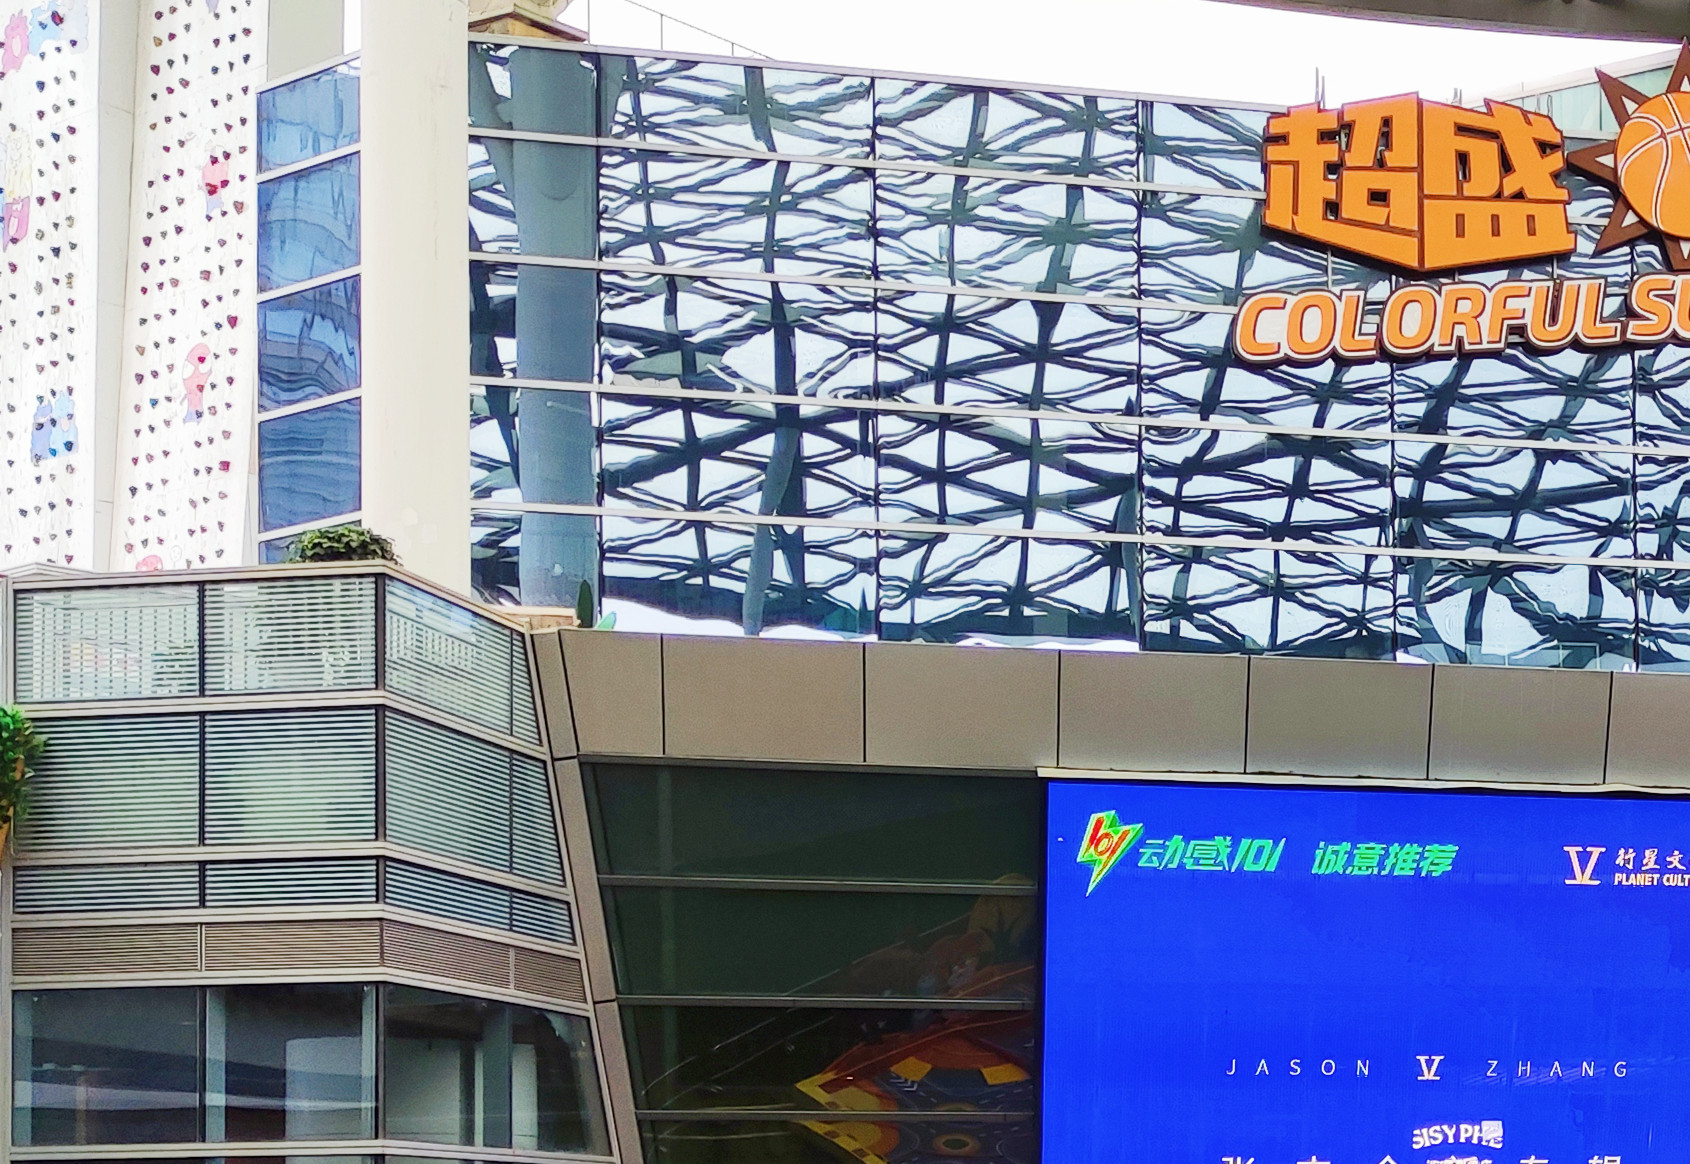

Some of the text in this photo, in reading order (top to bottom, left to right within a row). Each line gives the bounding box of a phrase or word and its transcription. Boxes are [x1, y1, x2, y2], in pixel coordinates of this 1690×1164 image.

[1233, 278, 1622, 362] COLORFUL
[1311, 841, 1459, 877] 诚意推荐
[1614, 872, 1660, 886] PLANET
[1226, 1059, 1369, 1077] JASON
[1487, 1060, 1627, 1077] ZHANG
